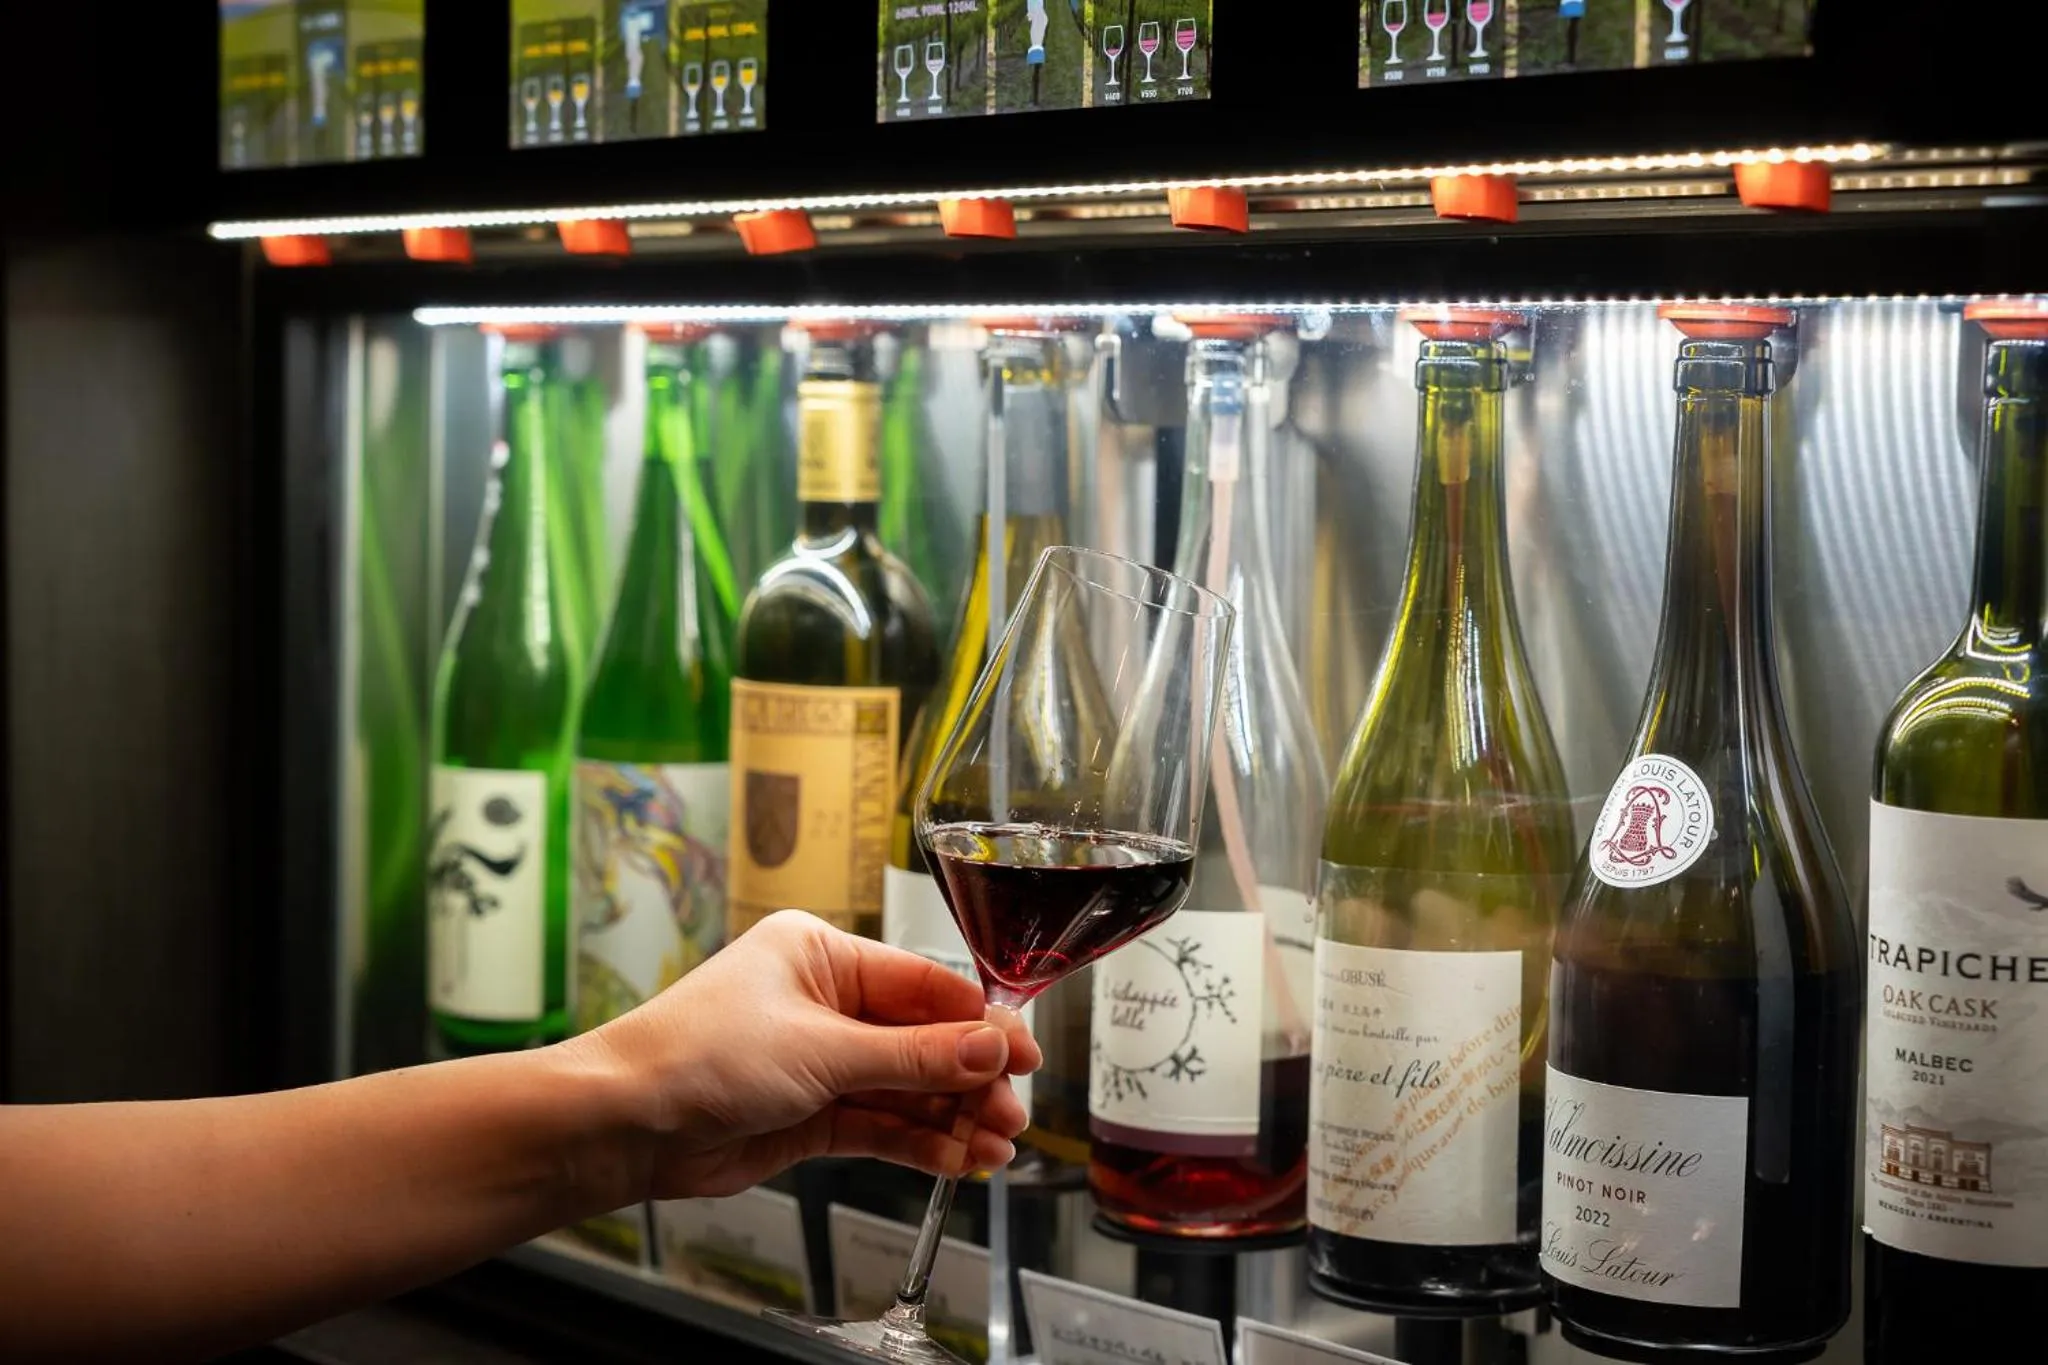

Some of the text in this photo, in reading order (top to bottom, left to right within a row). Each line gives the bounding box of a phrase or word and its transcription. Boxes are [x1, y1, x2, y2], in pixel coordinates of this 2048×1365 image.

[1633, 763, 1702, 850] LOUIS LATOUR
[1631, 866, 1656, 878] 1797
[1869, 933, 2048, 984] TRAPICHE
[1882, 984, 1998, 1020] OAK CASK
[1894, 1047, 1974, 1074] MALBEC
[1911, 1070, 1946, 1086] 2021
[1556, 1171, 1648, 1205] PINOT NOIR
[1574, 1205, 1612, 1228] 2022
[1582, 1238, 1682, 1287] Latour
